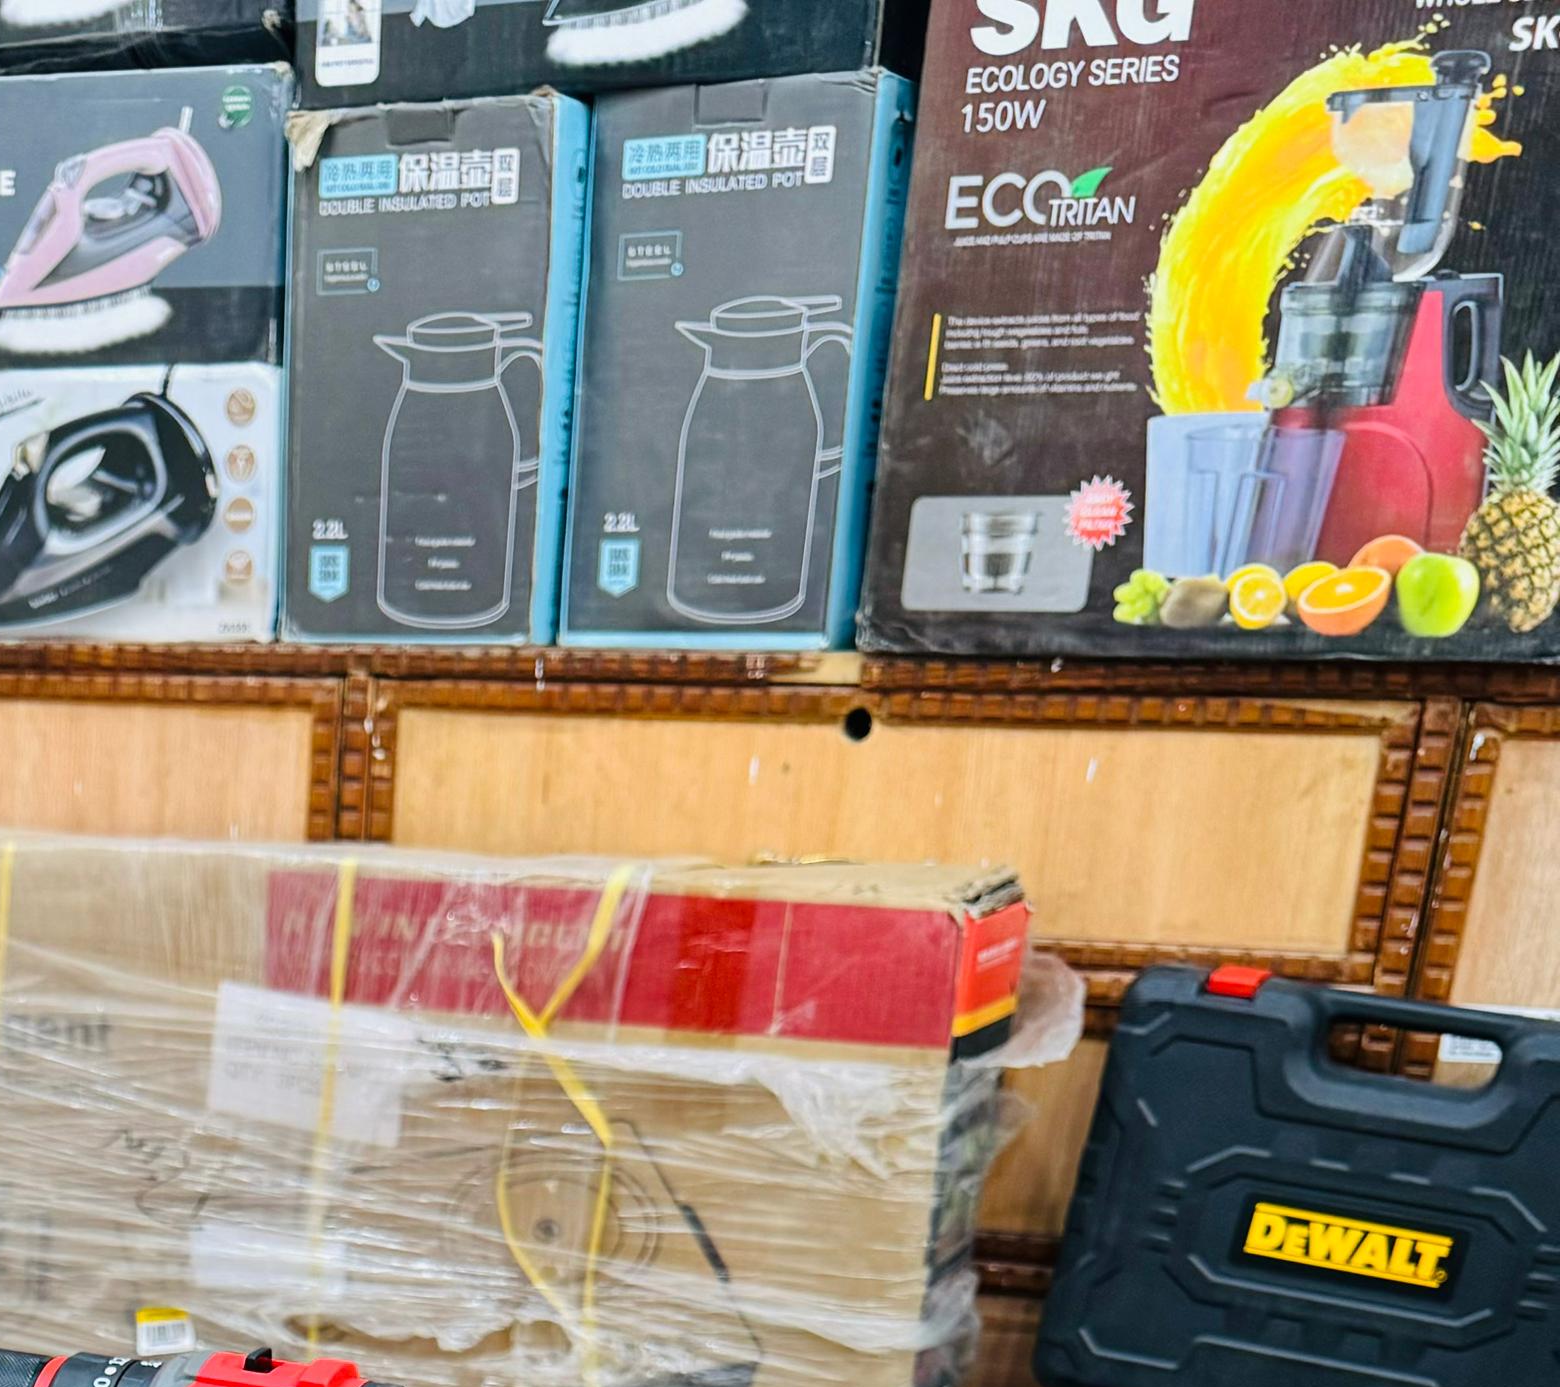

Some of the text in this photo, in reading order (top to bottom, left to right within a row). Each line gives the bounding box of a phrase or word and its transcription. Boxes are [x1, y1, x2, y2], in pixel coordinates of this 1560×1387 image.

[970, 0, 1194, 56] SKG
[1509, 14, 1560, 51] SK
[965, 55, 1180, 94] ECOLOGY SERIES
[961, 99, 1047, 133] 150W
[622, 171, 803, 199] DOUBLE INSULATED POT
[944, 170, 1136, 230] ECO TRITAN
[318, 191, 490, 217] DOUBLE INSULATED POT
